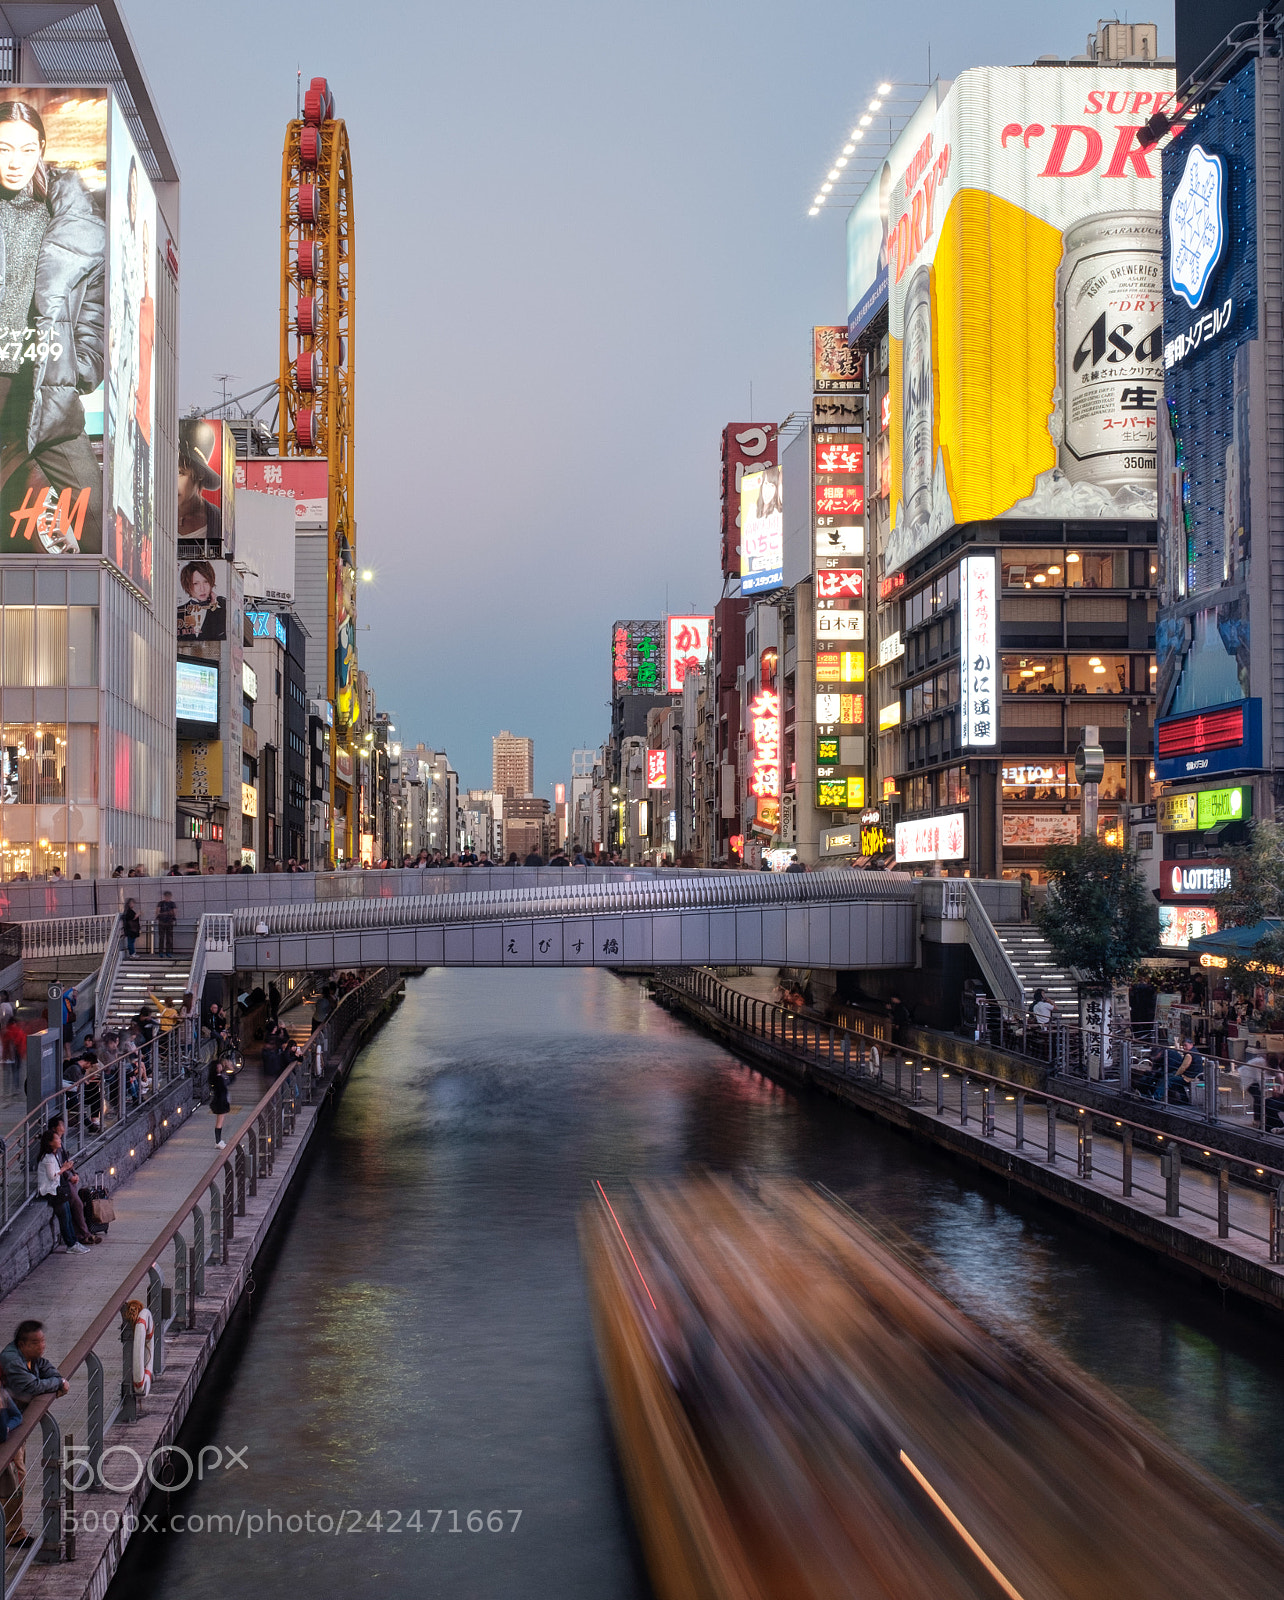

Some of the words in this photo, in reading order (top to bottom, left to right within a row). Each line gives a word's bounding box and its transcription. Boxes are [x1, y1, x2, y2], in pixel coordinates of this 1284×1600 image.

[1087, 276, 1108, 298] ASAHI
[1110, 264, 1159, 279] BREWERIES
[1164, 298, 1232, 370] 雪印メグミルク
[818, 379, 831, 389] 9F
[1120, 386, 1157, 411] 生
[1122, 431, 1157, 442] 生ビール
[1124, 457, 1156, 469] 350ml
[9, 486, 92, 541] H&M
[817, 499, 863, 512] ダイニング
[826, 559, 839, 568] 5F
[819, 615, 861, 631] 白木屋
[751, 690, 779, 797] 大阪王将
[817, 767, 834, 776] B1F
[1183, 868, 1232, 890] LOTTERIA
[507, 938, 619, 955] えびす橋
